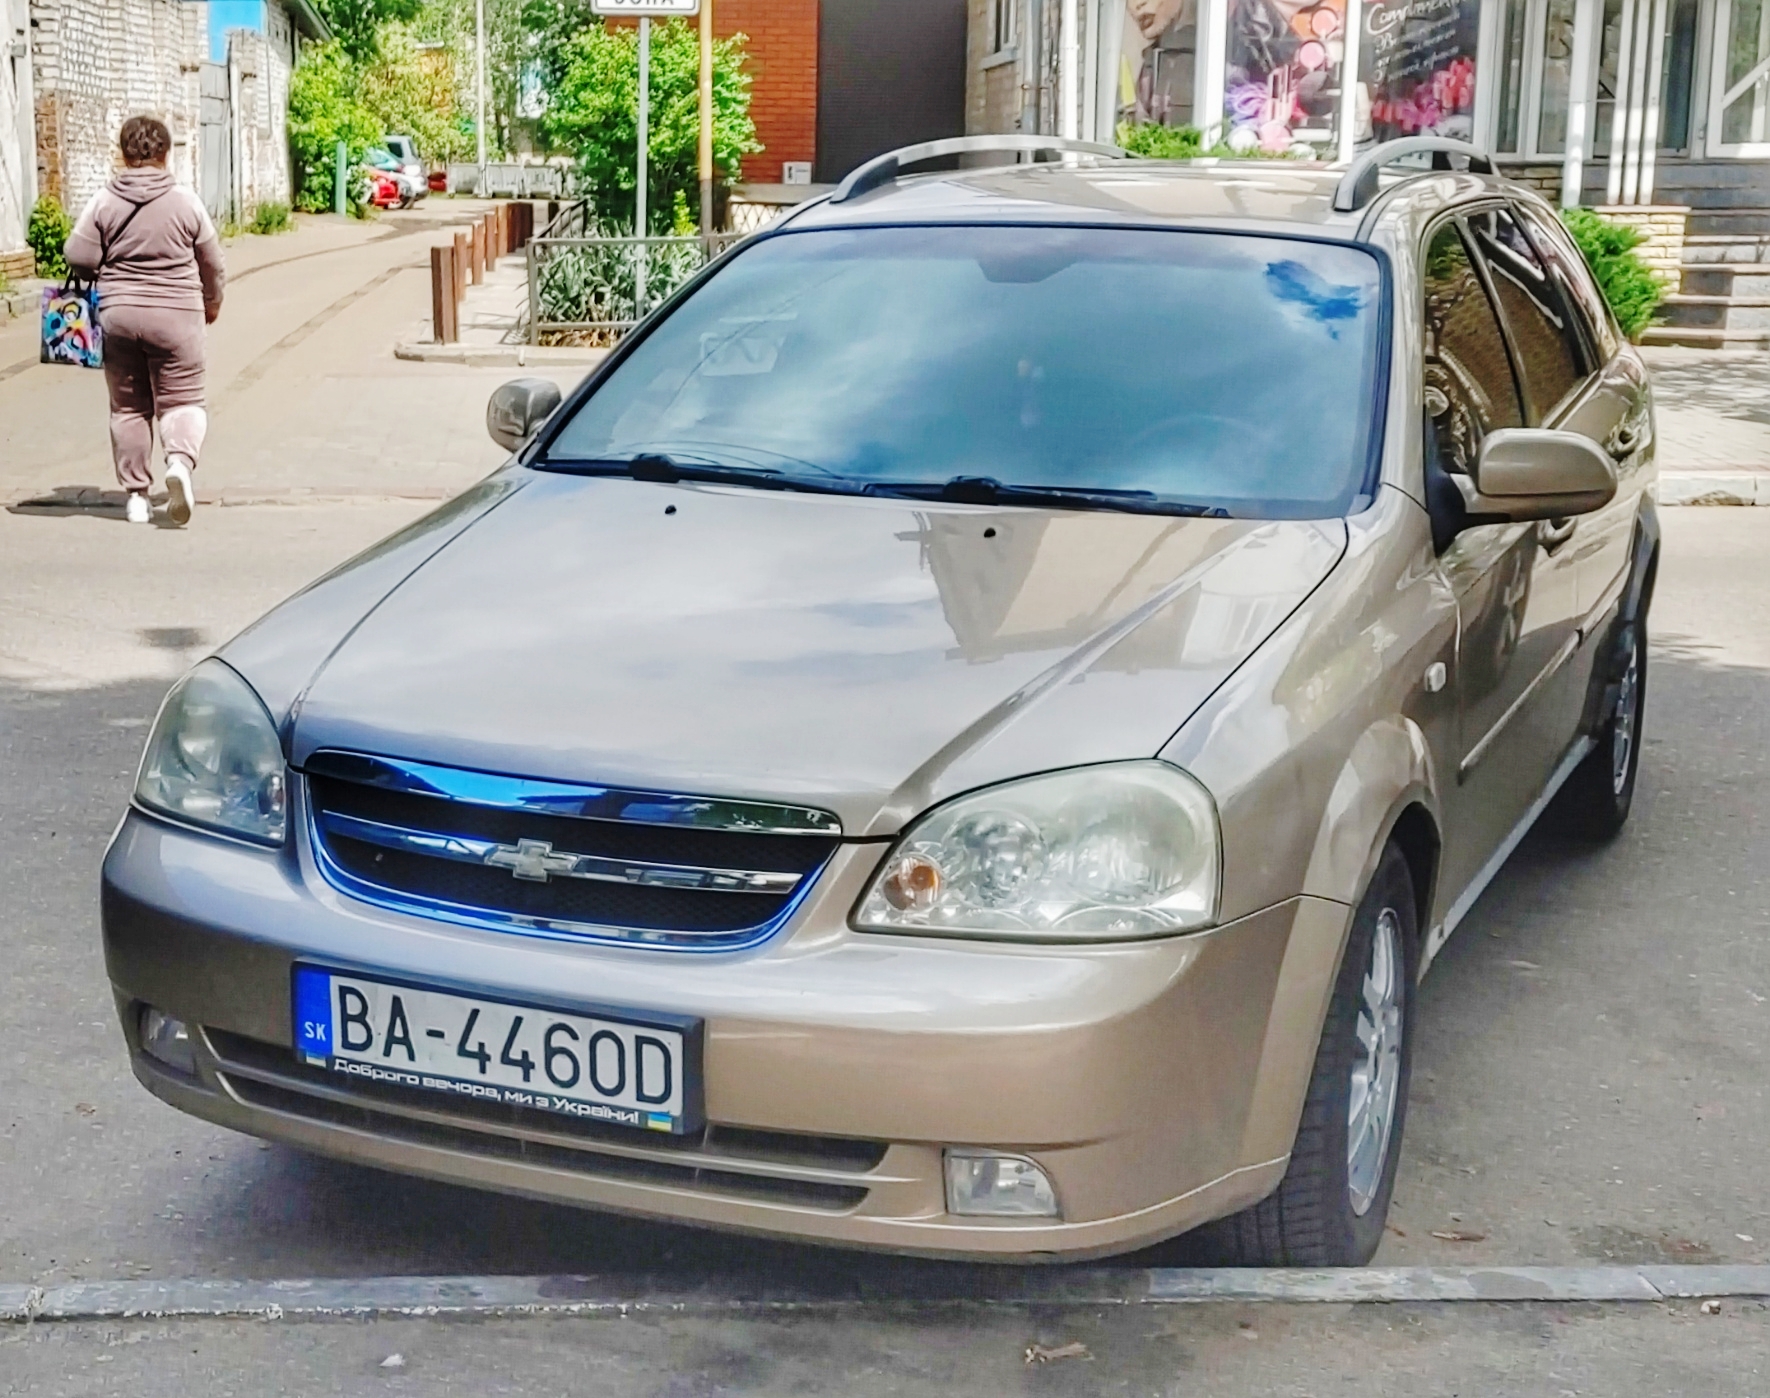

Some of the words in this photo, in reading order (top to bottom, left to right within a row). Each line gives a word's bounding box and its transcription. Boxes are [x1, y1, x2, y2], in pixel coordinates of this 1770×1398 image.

[304, 1021, 326, 1042] SK
[334, 1058, 420, 1085] Доброго
[423, 1077, 501, 1102] вечора,
[504, 1090, 533, 1105] ми
[535, 1096, 550, 1108] з
[553, 1096, 639, 1125] України!
